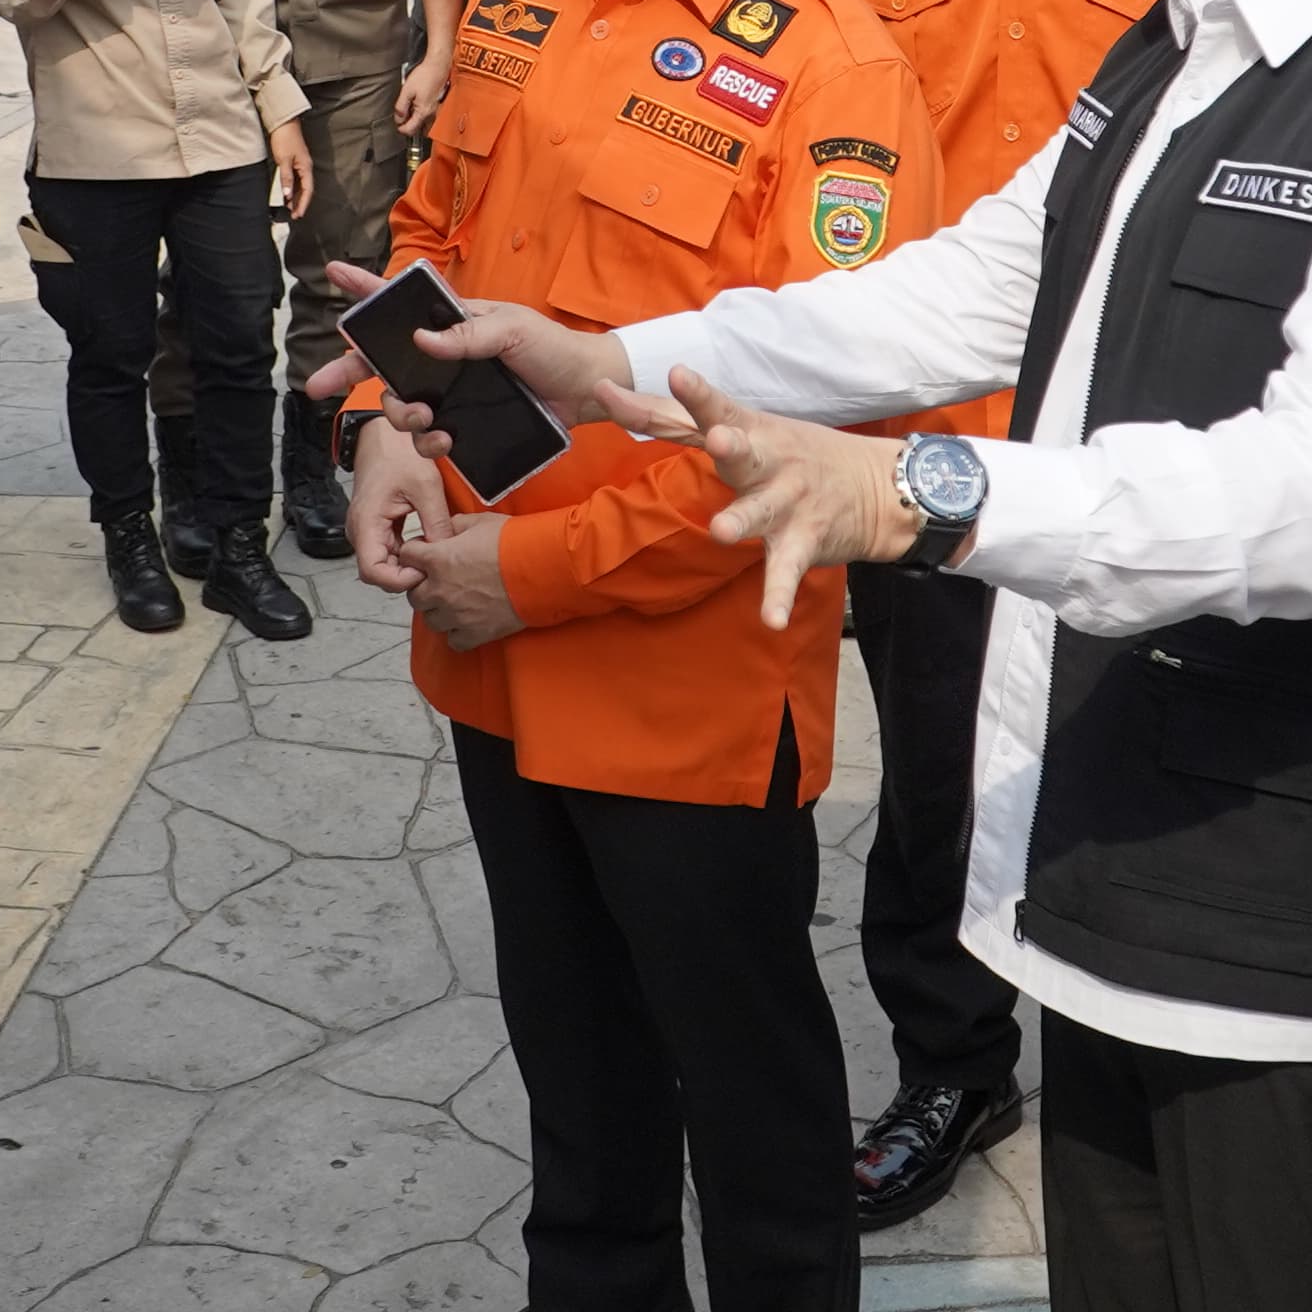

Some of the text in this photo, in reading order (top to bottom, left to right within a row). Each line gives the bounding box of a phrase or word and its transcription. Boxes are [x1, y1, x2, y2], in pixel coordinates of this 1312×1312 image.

[480, 50, 530, 82] SETIADI
[709, 65, 778, 110] RESCUE
[631, 100, 734, 161] GUBERNUR
